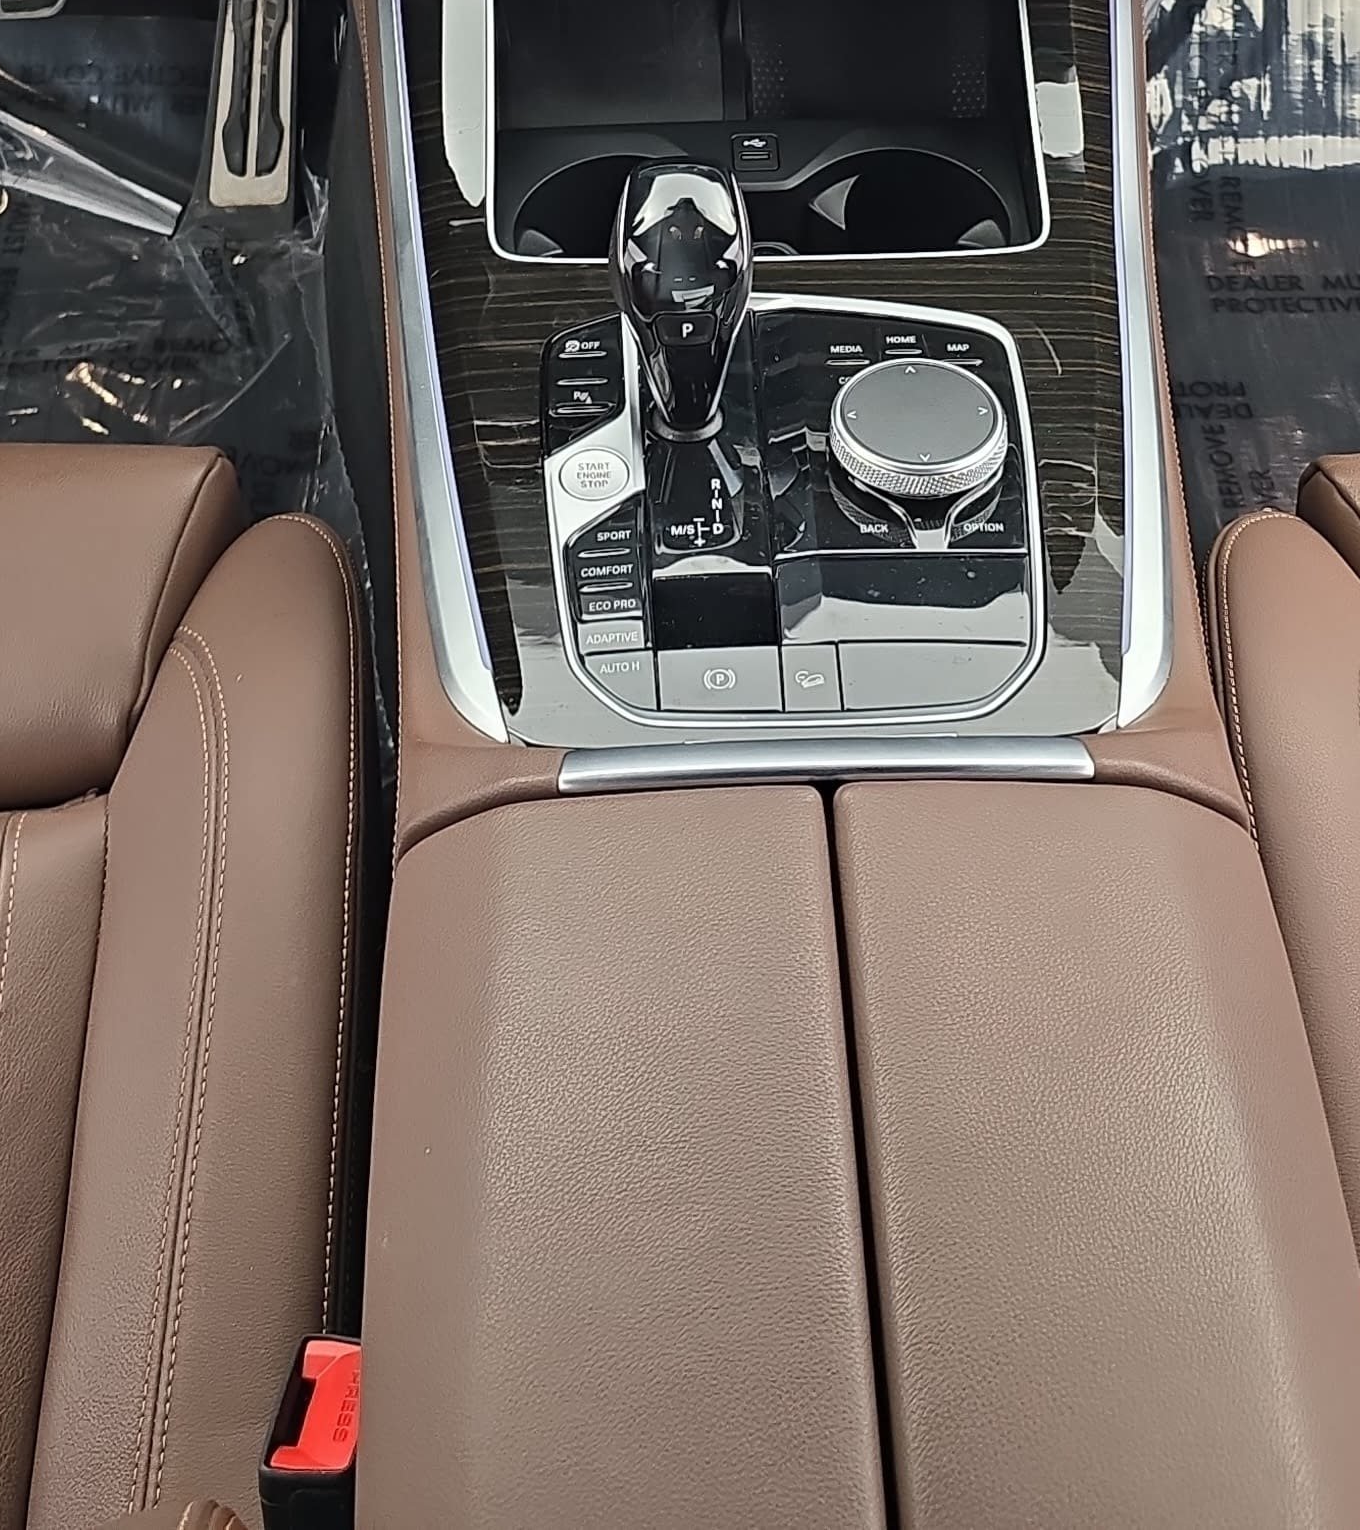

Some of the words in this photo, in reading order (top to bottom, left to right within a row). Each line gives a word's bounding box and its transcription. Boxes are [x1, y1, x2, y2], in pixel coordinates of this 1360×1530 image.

[1206, 274, 1305, 293] DEALER
[682, 323, 694, 338] P
[885, 335, 917, 344] HOME
[580, 340, 601, 351] OFF
[830, 344, 863, 354] MEDIA
[946, 343, 970, 352] MAP
[577, 462, 610, 471] START
[576, 471, 612, 479] ENGINE
[580, 479, 609, 488] STOP
[710, 478, 721, 490] R
[711, 498, 722, 510] N
[670, 525, 695, 536] M/S
[712, 525, 724, 535] D
[860, 523, 889, 534] BACK
[963, 522, 1005, 533] OPTION
[596, 529, 632, 542] SPORT
[580, 563, 634, 578] COMFORT
[588, 600, 611, 611] ECO
[613, 598, 636, 610] PRO
[586, 631, 639, 646] ADAPTIVE
[599, 662, 628, 675] AUTO
[631, 660, 640, 671] H
